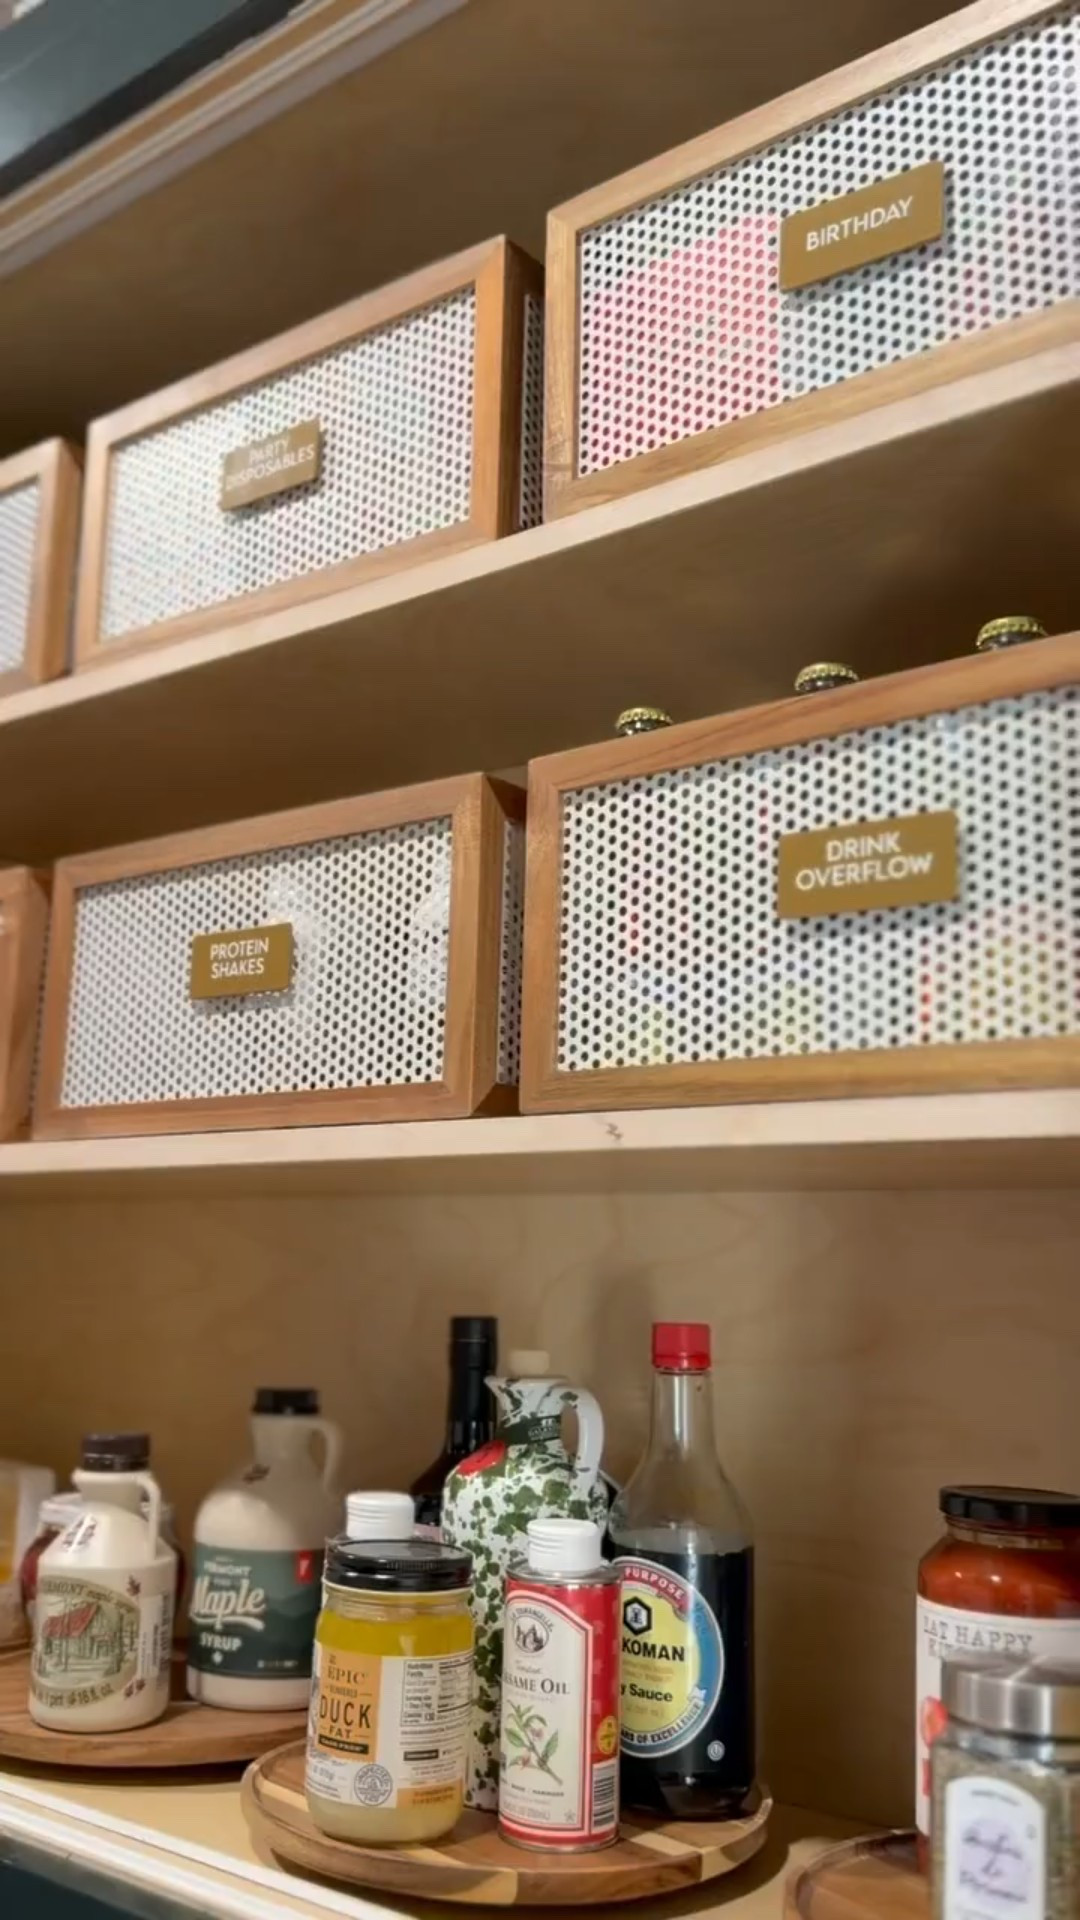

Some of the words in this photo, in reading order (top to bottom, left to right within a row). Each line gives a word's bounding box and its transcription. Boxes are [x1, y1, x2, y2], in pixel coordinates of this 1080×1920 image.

[806, 196, 913, 252] BIRTHDAY
[249, 439, 289, 465] PARTY
[826, 832, 901, 862] DRINK
[795, 852, 933, 891] OVERFLOW
[210, 937, 269, 960] PROTEIN
[211, 958, 265, 979] SHAKES
[624, 1566, 685, 1600] PURPOSE
[621, 1637, 685, 1662] KOMAN
[955, 1625, 1032, 1655] HAPPY
[327, 1665, 366, 1684] EPIC
[629, 1683, 673, 1702] Sauce
[320, 1694, 371, 1729] DUCK
[329, 1724, 352, 1739] FAT
